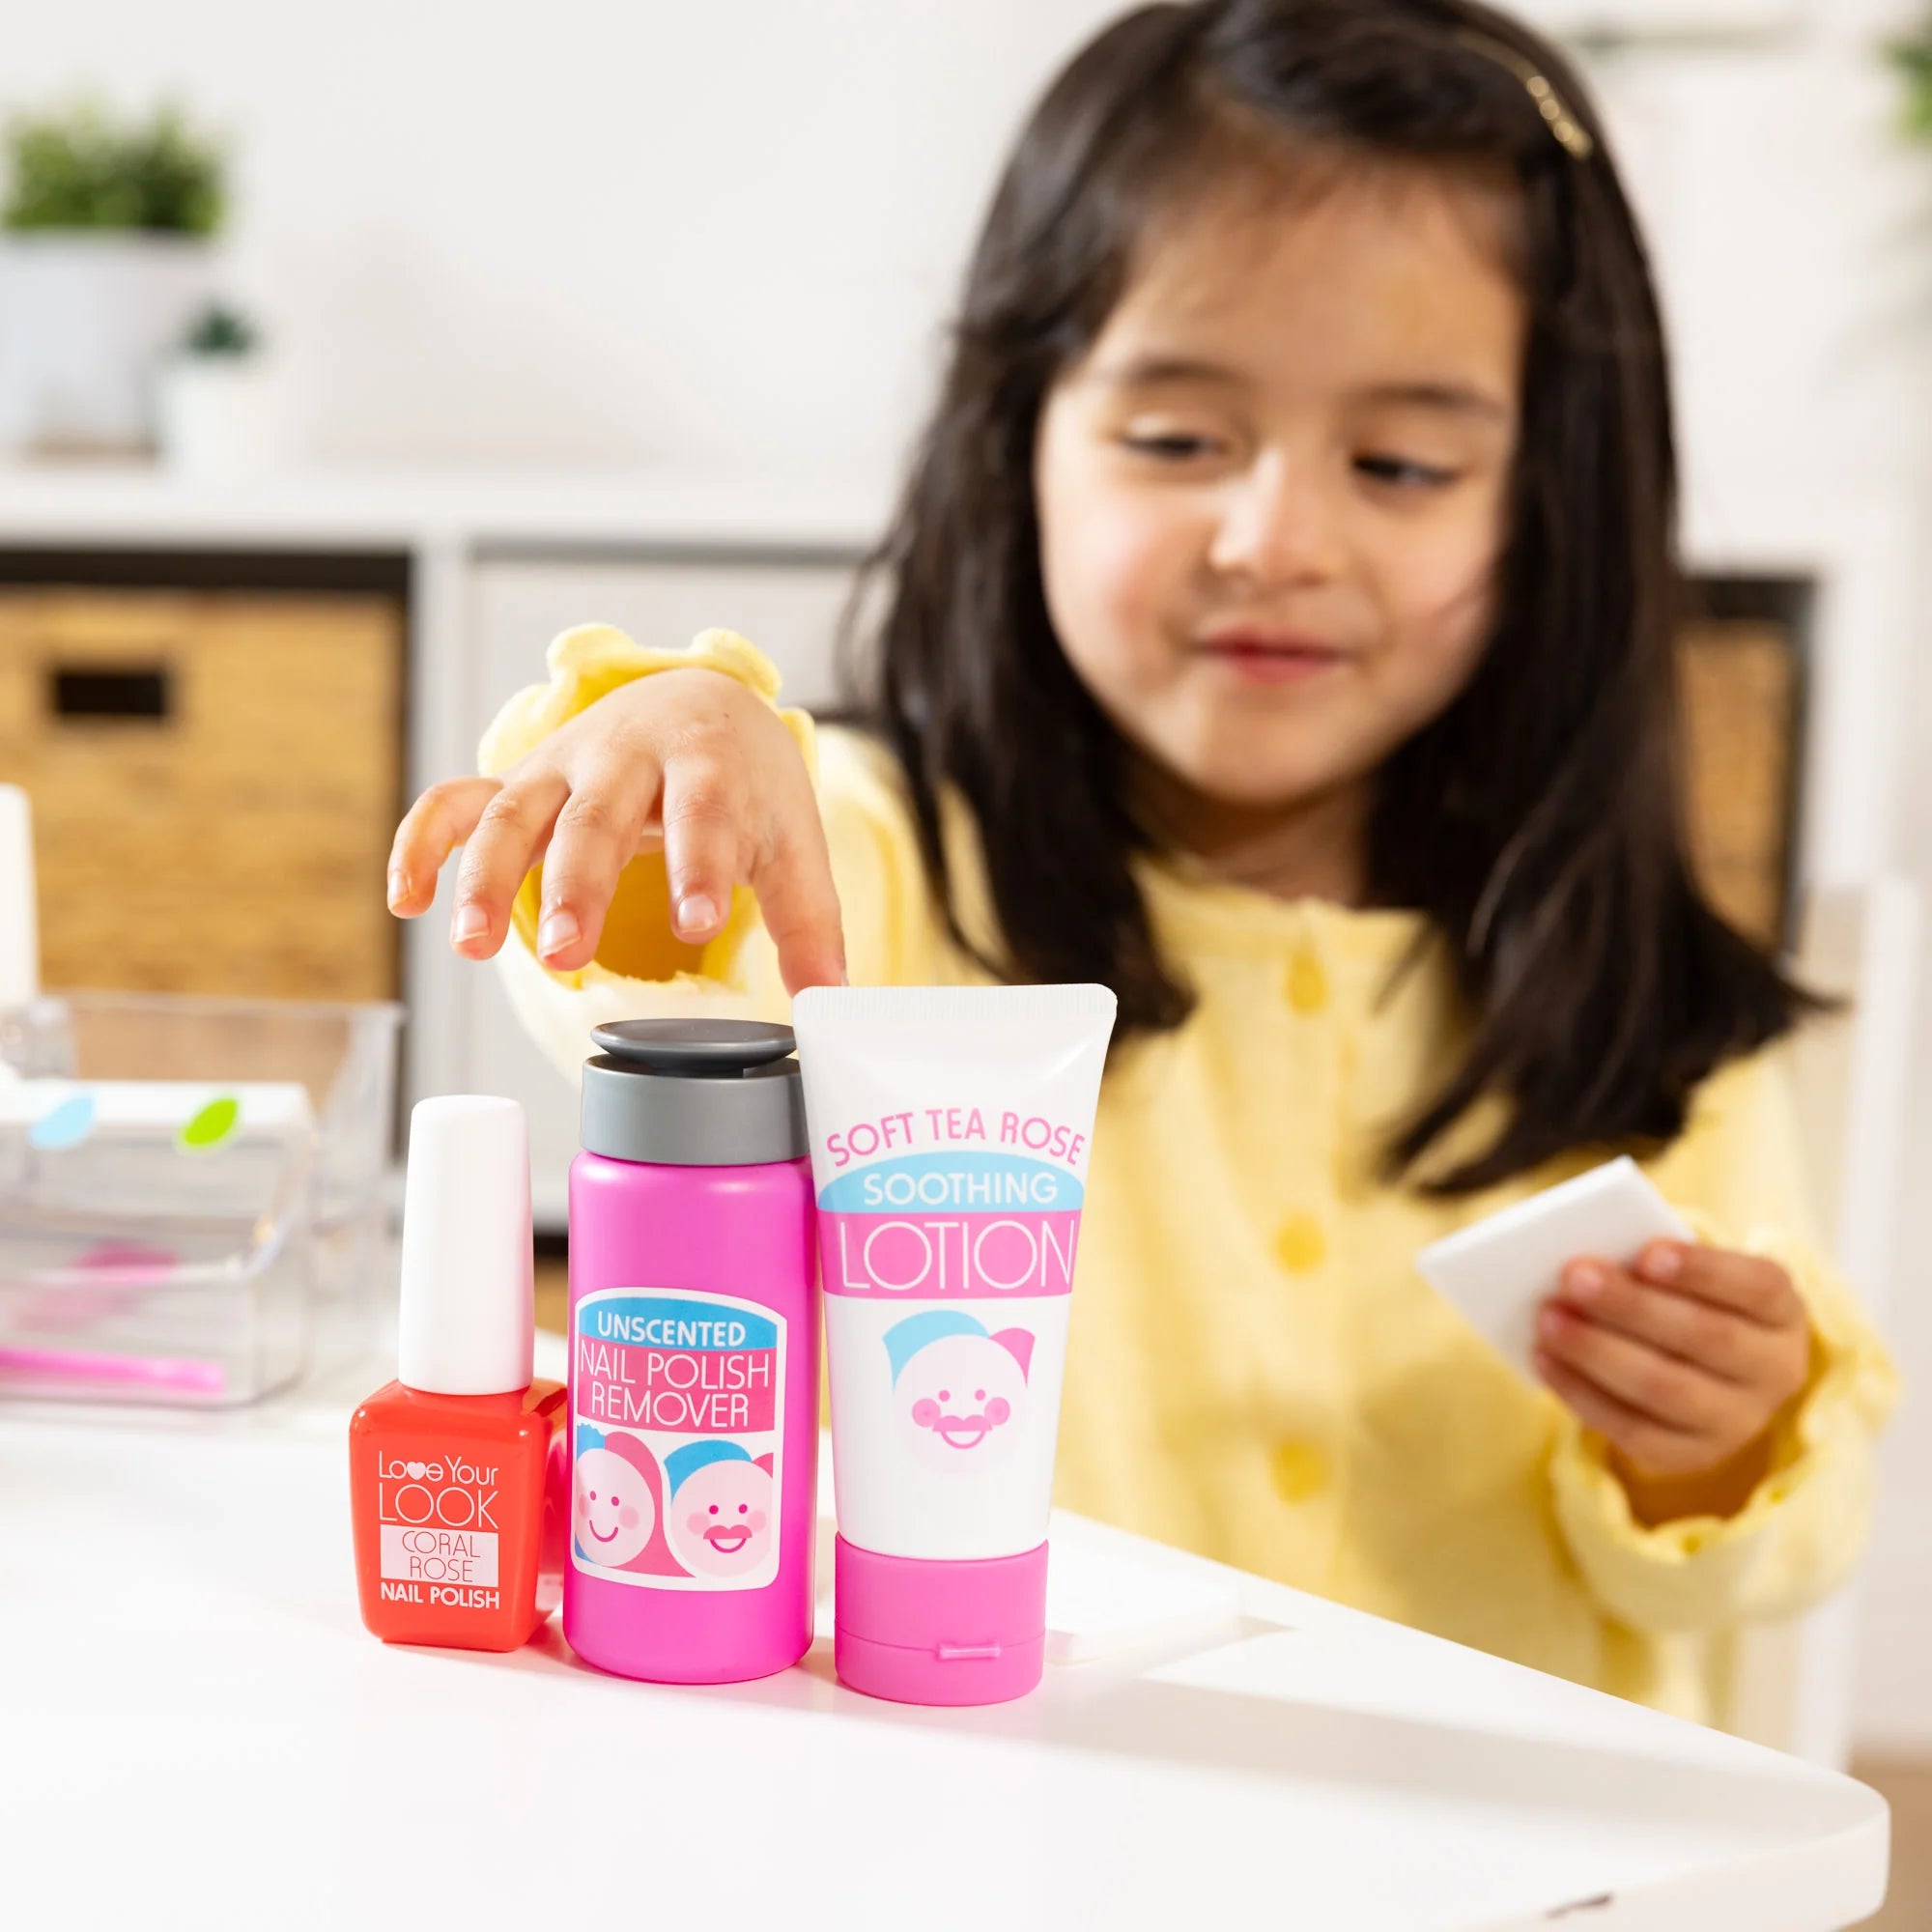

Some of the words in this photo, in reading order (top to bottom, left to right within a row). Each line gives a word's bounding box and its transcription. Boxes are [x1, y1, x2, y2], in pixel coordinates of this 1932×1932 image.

[826, 1112, 913, 1167] SOFT
[924, 1107, 986, 1141] TEA
[1000, 1111, 1086, 1166] ROSE
[863, 1172, 1059, 1206] SOOTHING
[839, 1219, 1075, 1291] LOTION
[597, 1310, 747, 1347] UNSCENTED
[581, 1339, 636, 1384] NAIL
[647, 1352, 769, 1390] POLISH
[591, 1380, 749, 1428] REMOVER
[444, 1455, 499, 1486] Your
[379, 1482, 499, 1529] LOOK
[402, 1530, 481, 1558] CORAL
[410, 1555, 473, 1582] ROSE
[381, 1581, 424, 1604] NAIL
[430, 1586, 500, 1609] POLISH
